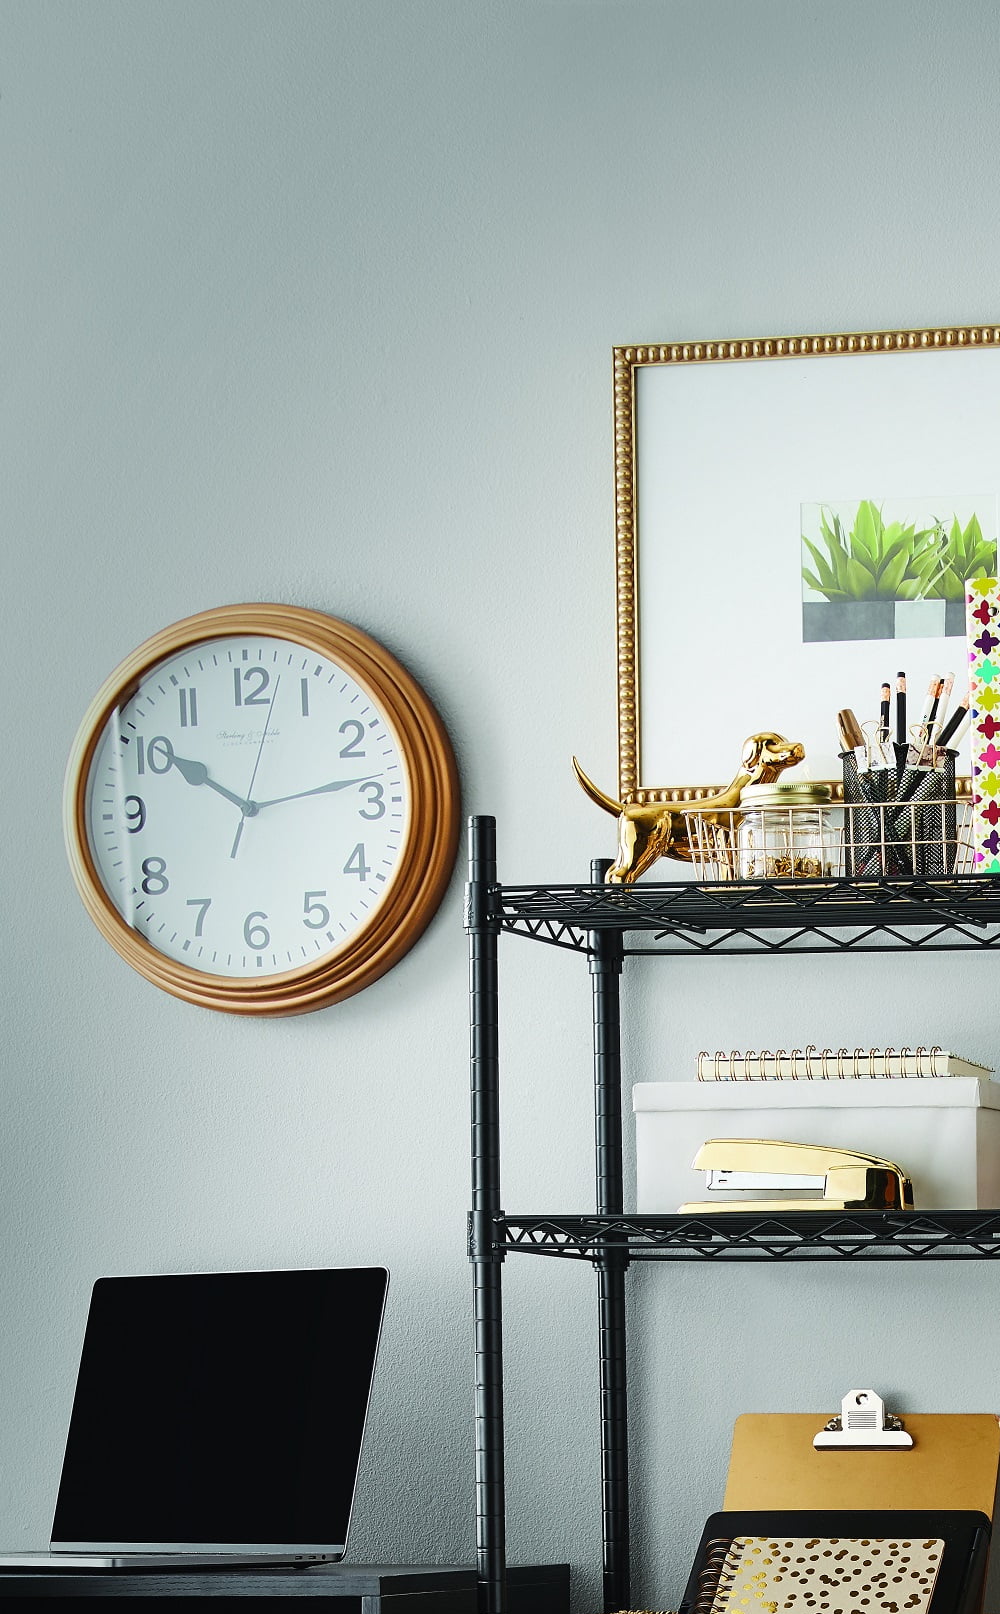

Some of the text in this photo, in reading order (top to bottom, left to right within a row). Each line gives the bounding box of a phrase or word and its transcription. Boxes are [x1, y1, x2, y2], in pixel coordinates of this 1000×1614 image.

[234, 667, 271, 706] 12
[300, 678, 309, 717] 1
[179, 688, 198, 727] 11
[137, 736, 174, 774] 10
[339, 720, 366, 758] 2
[124, 795, 146, 833] 9
[358, 782, 385, 820] 3
[141, 857, 169, 895] 8
[344, 843, 371, 881] 4
[186, 898, 211, 936] 7
[303, 891, 330, 929] 5
[243, 912, 270, 950] 6
